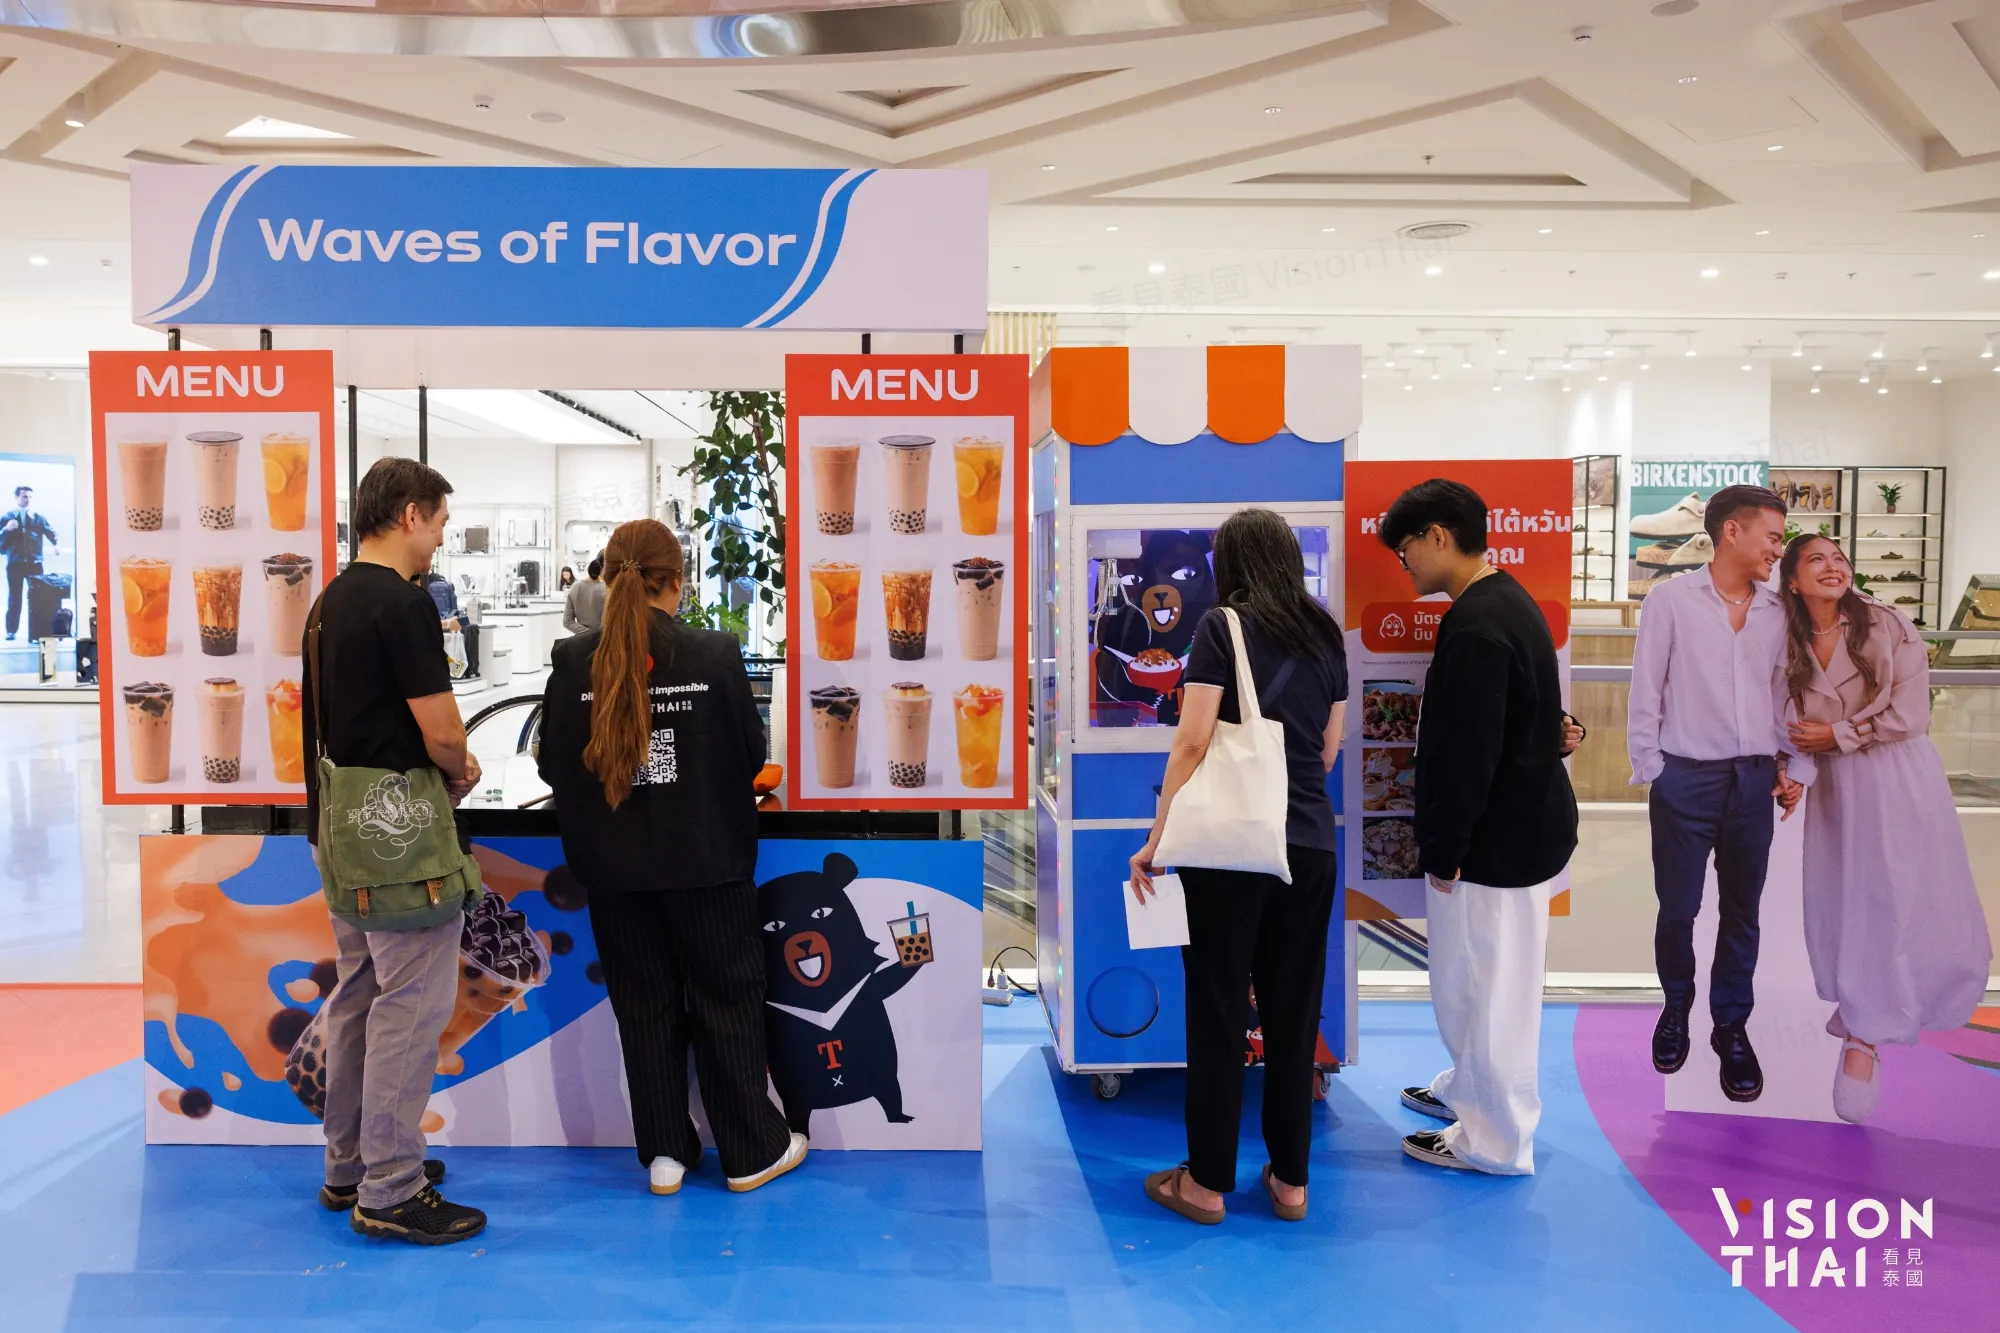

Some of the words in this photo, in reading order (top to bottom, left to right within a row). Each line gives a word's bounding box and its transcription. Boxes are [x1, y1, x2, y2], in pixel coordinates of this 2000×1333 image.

[258, 219, 482, 263] Waves
[500, 222, 568, 264] of
[586, 221, 797, 266] Flavor
[136, 365, 285, 398] MENU
[831, 368, 979, 401] MENU
[655, 683, 710, 696] Impossible
